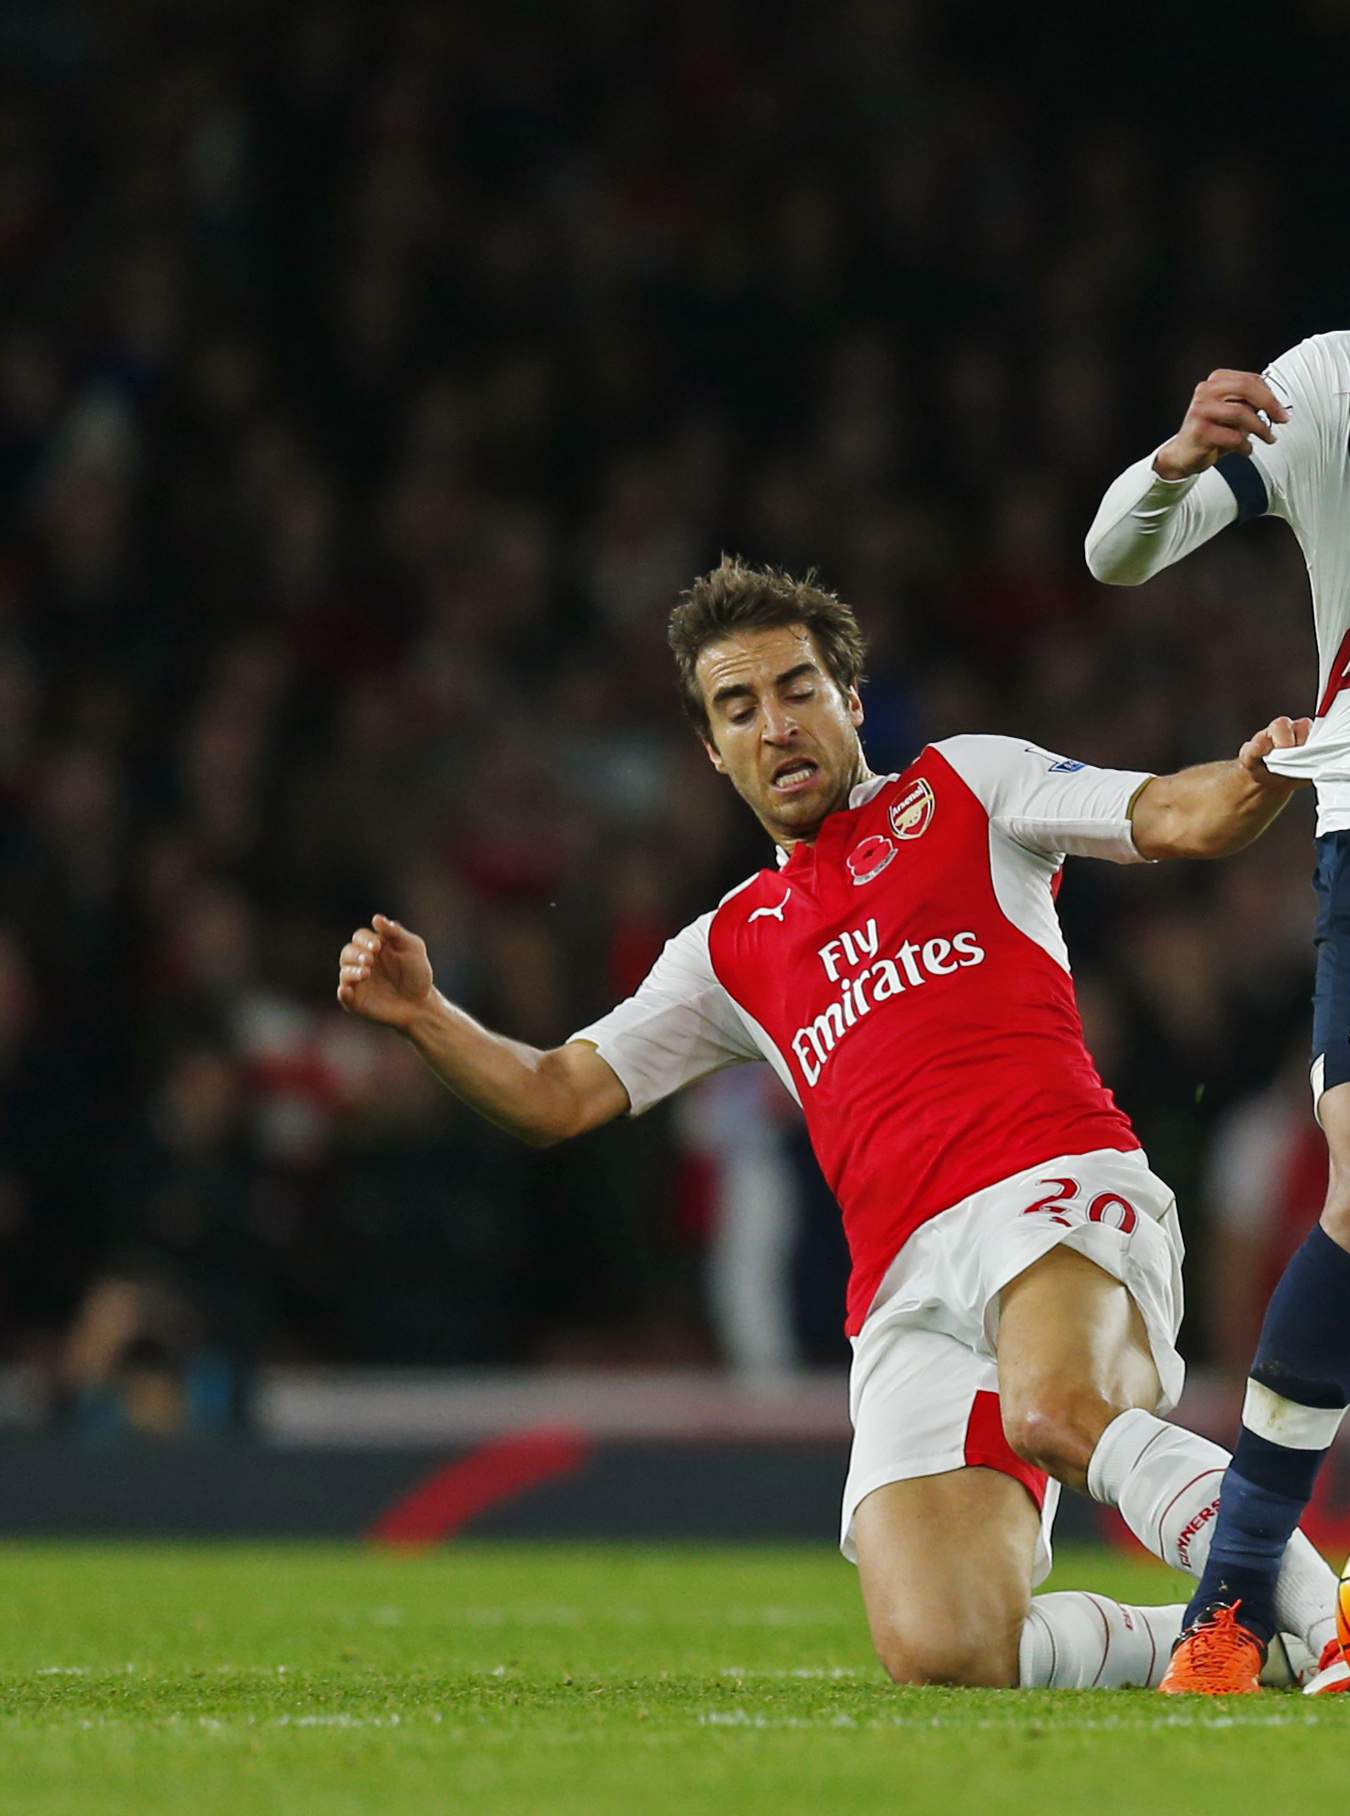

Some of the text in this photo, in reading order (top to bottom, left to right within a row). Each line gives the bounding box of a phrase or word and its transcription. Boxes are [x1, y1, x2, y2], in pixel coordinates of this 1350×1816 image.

[818, 917, 880, 983] Fly
[792, 931, 986, 1089] Emirates
[1021, 1177, 1138, 1235] 20
